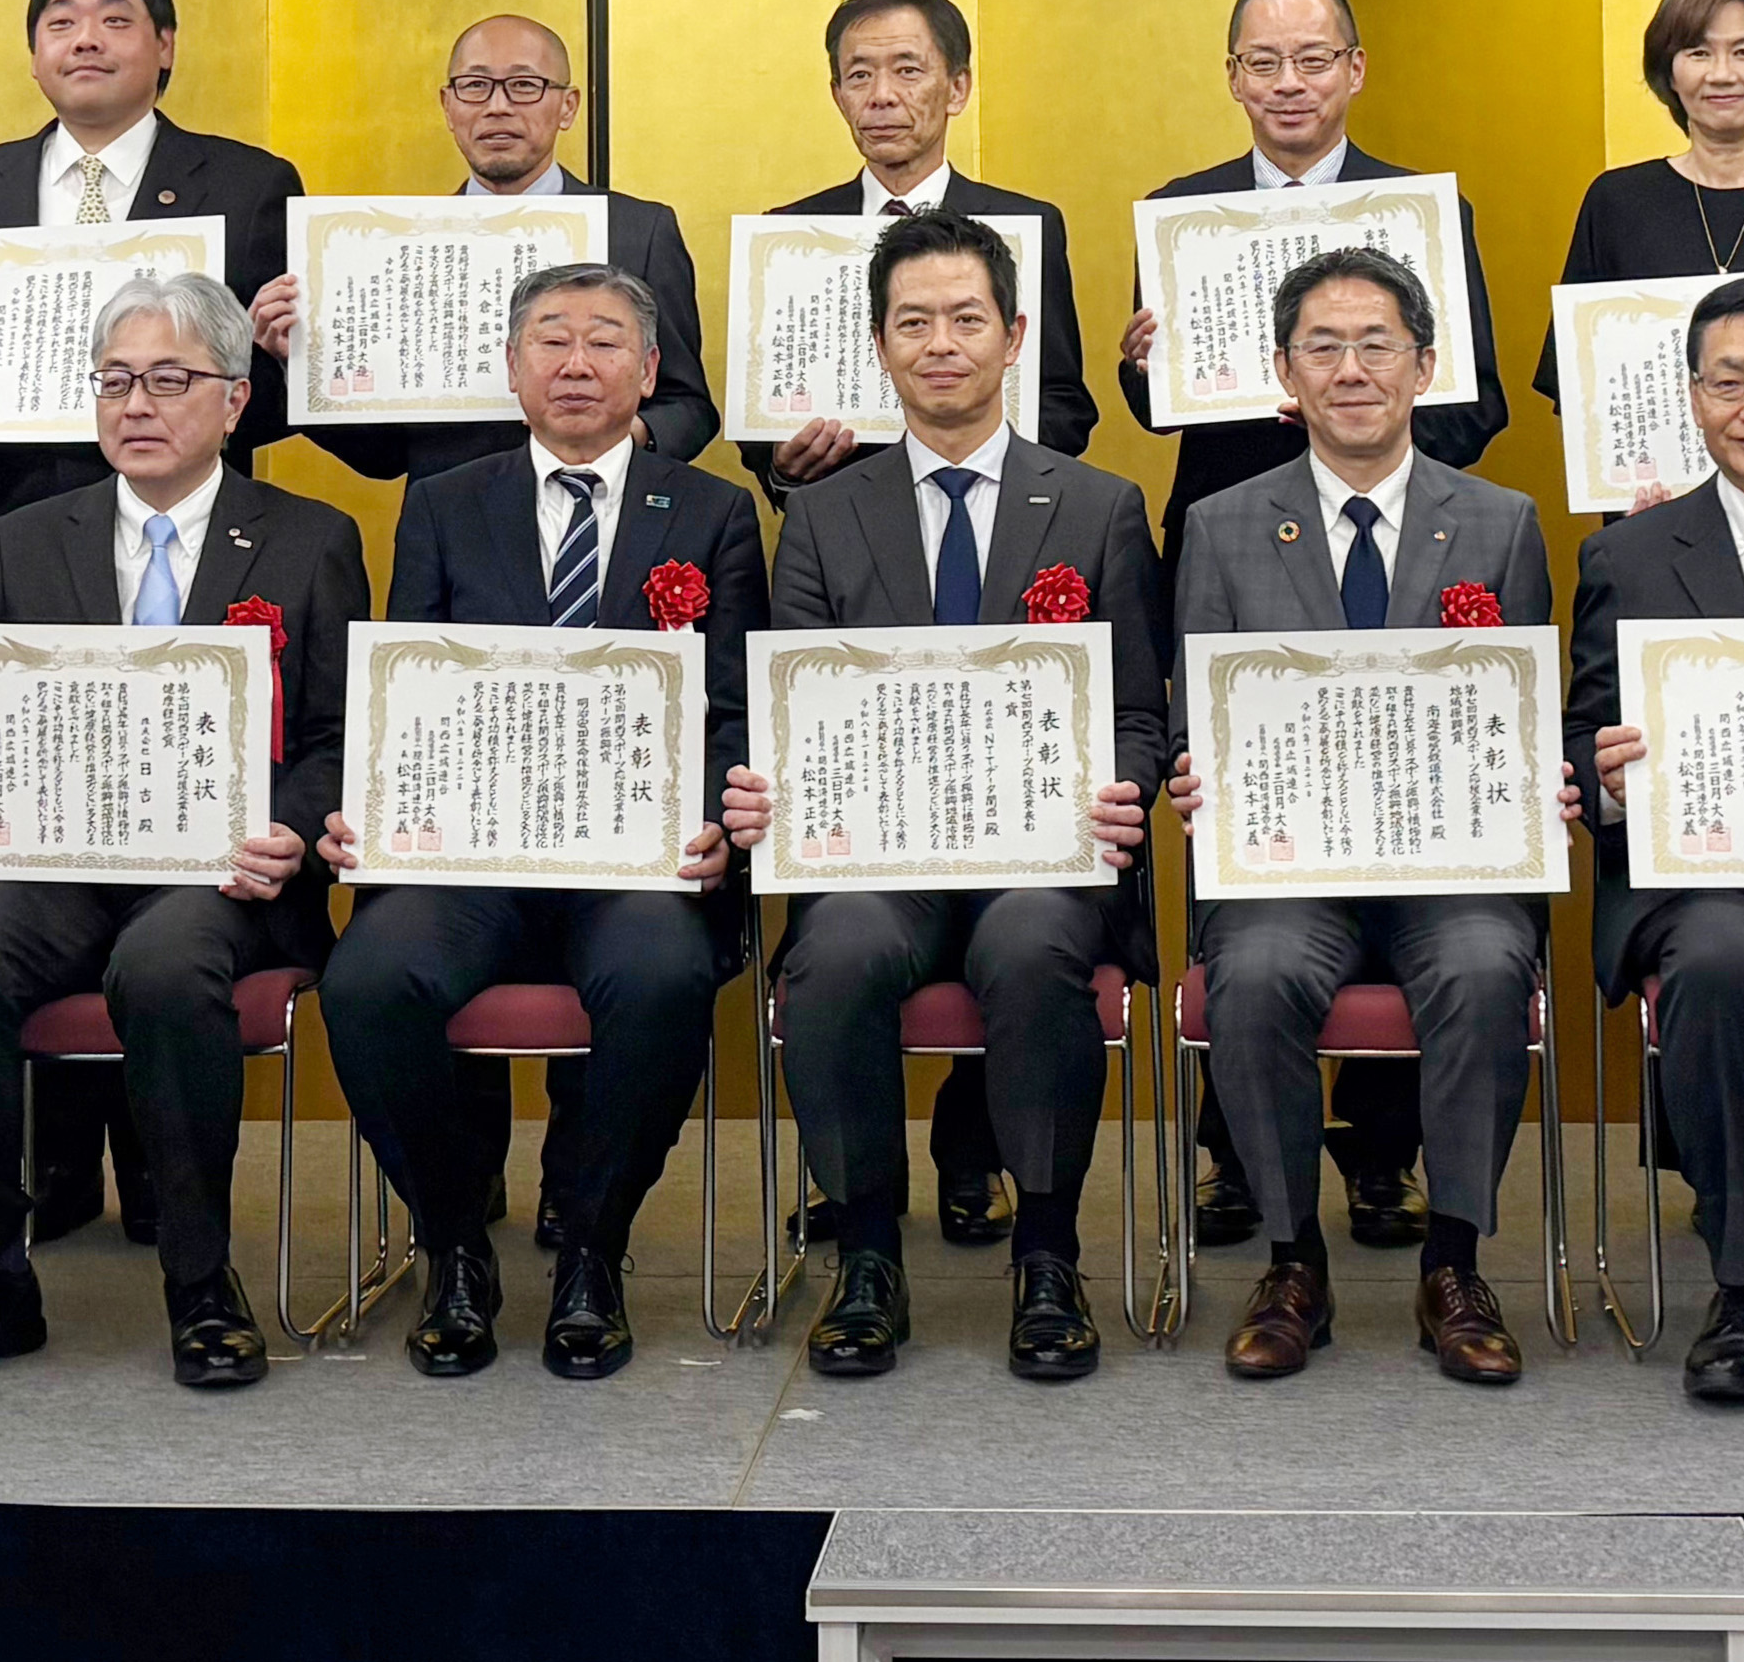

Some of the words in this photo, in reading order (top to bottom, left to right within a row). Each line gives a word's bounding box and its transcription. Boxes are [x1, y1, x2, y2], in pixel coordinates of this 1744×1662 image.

[477, 280, 492, 373] 大倉直也殿
[1005, 680, 1018, 717] 大賞
[193, 712, 217, 801] 表彰状
[631, 713, 653, 802] 表彰状
[1038, 709, 1063, 799] 表彰状
[1484, 714, 1511, 804] 表彰状
[422, 764, 436, 833] 三日月大造
[831, 768, 844, 837] 三日月大造
[1272, 772, 1289, 843] 三日月大造
[1709, 762, 1725, 834] 三日月大造
